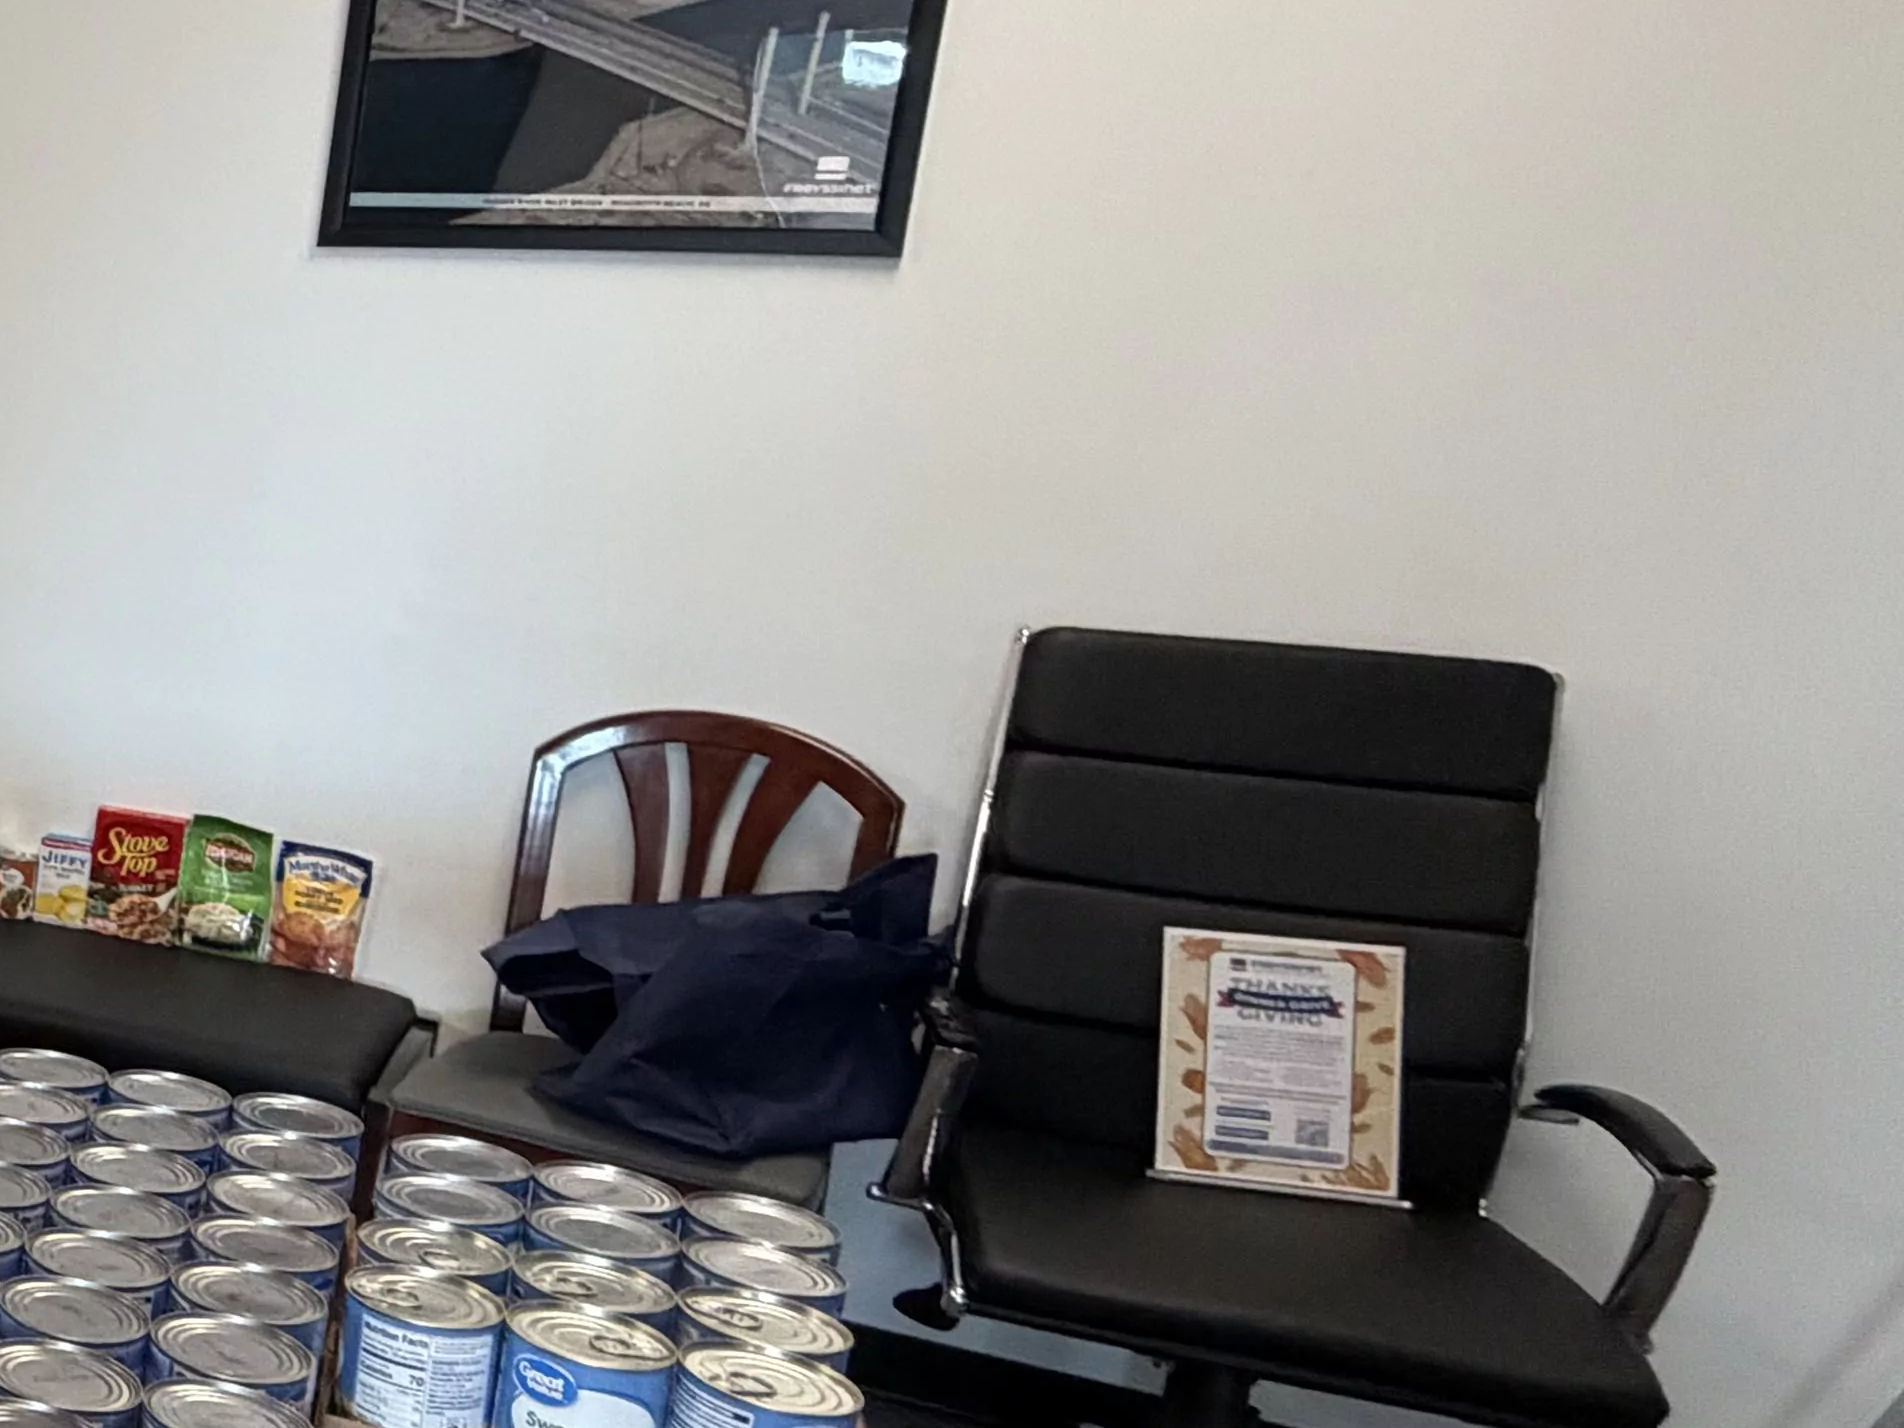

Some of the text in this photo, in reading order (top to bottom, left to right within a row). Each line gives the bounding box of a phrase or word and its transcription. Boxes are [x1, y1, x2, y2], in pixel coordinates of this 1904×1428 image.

[97, 827, 170, 865] Stove
[42, 850, 88, 868] JIFFY
[119, 854, 158, 878] Top
[408, 1374, 425, 1387] 70
[519, 1360, 565, 1395] Great
